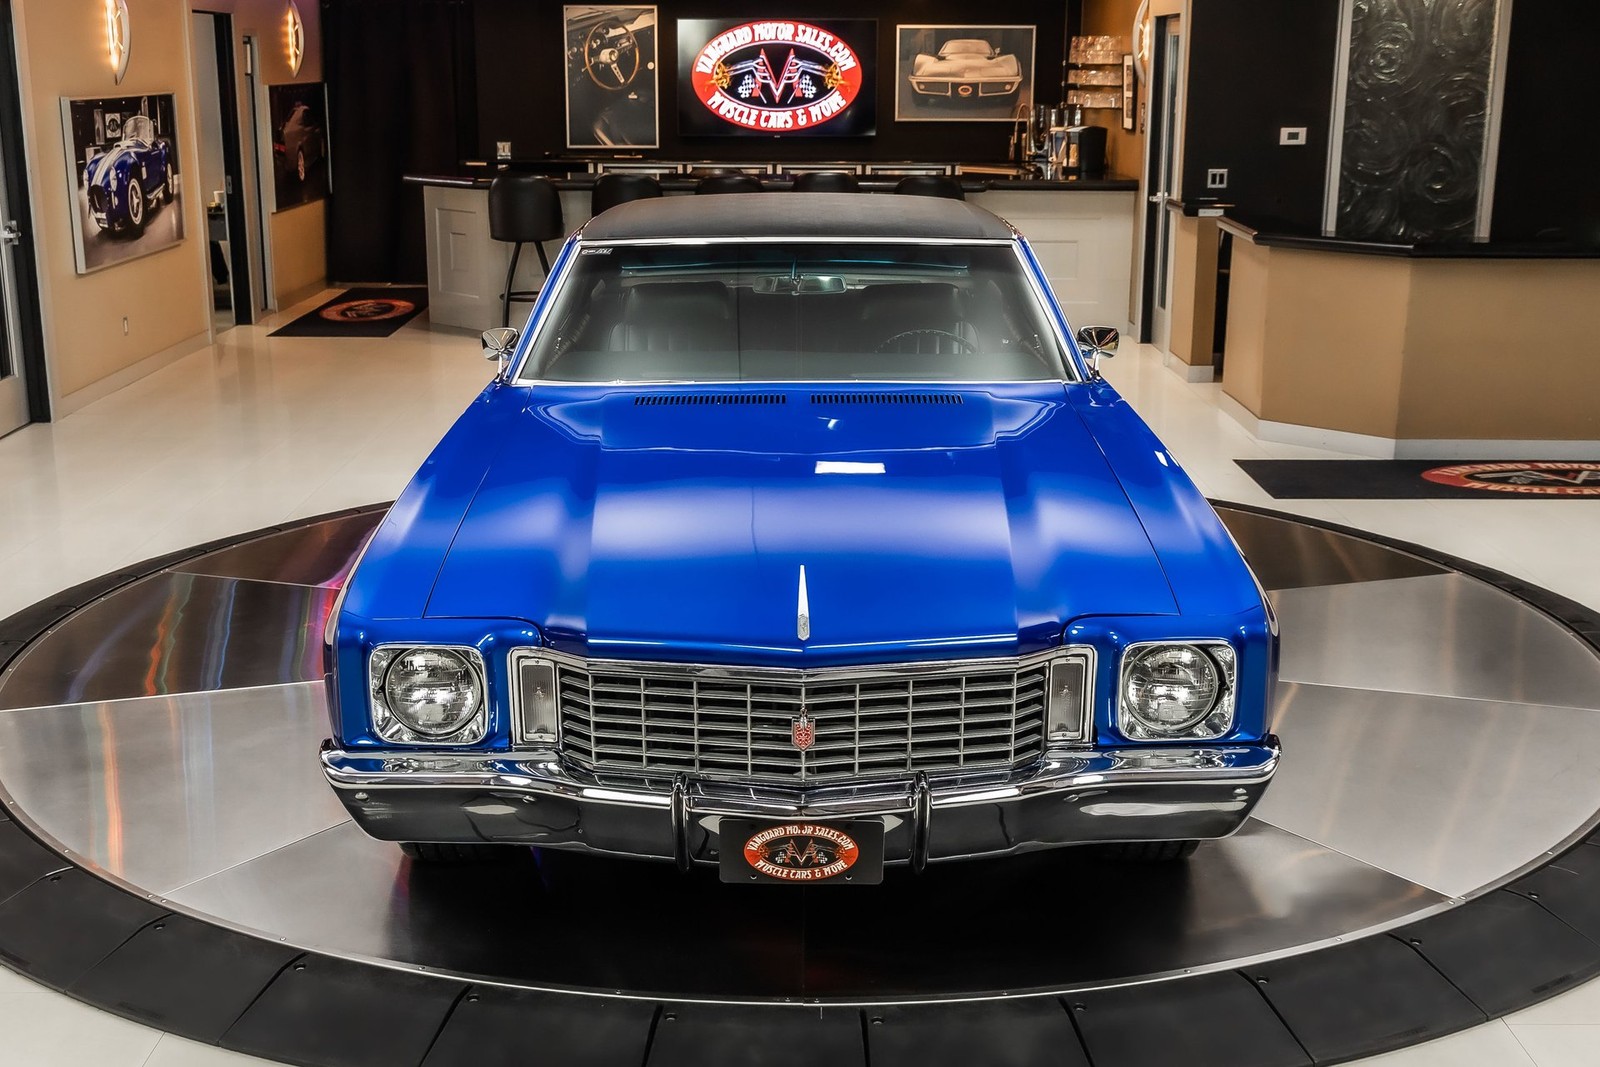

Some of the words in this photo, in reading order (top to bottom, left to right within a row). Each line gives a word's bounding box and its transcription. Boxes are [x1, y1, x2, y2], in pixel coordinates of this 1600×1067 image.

[696, 29, 753, 74] VANGUARD
[753, 23, 795, 41] MOTOR
[796, 25, 857, 72] SALES.COM
[706, 91, 759, 126] MUSCLE
[759, 110, 793, 129] CARS
[797, 109, 807, 126] &
[808, 91, 847, 123] MORE
[747, 827, 785, 851] VANGUARD
[814, 826, 855, 850] SALES.COM
[754, 859, 789, 878] MUSCLE
[790, 868, 812, 879] CARS
[815, 869, 822, 878] &
[823, 860, 848, 876] MORE
